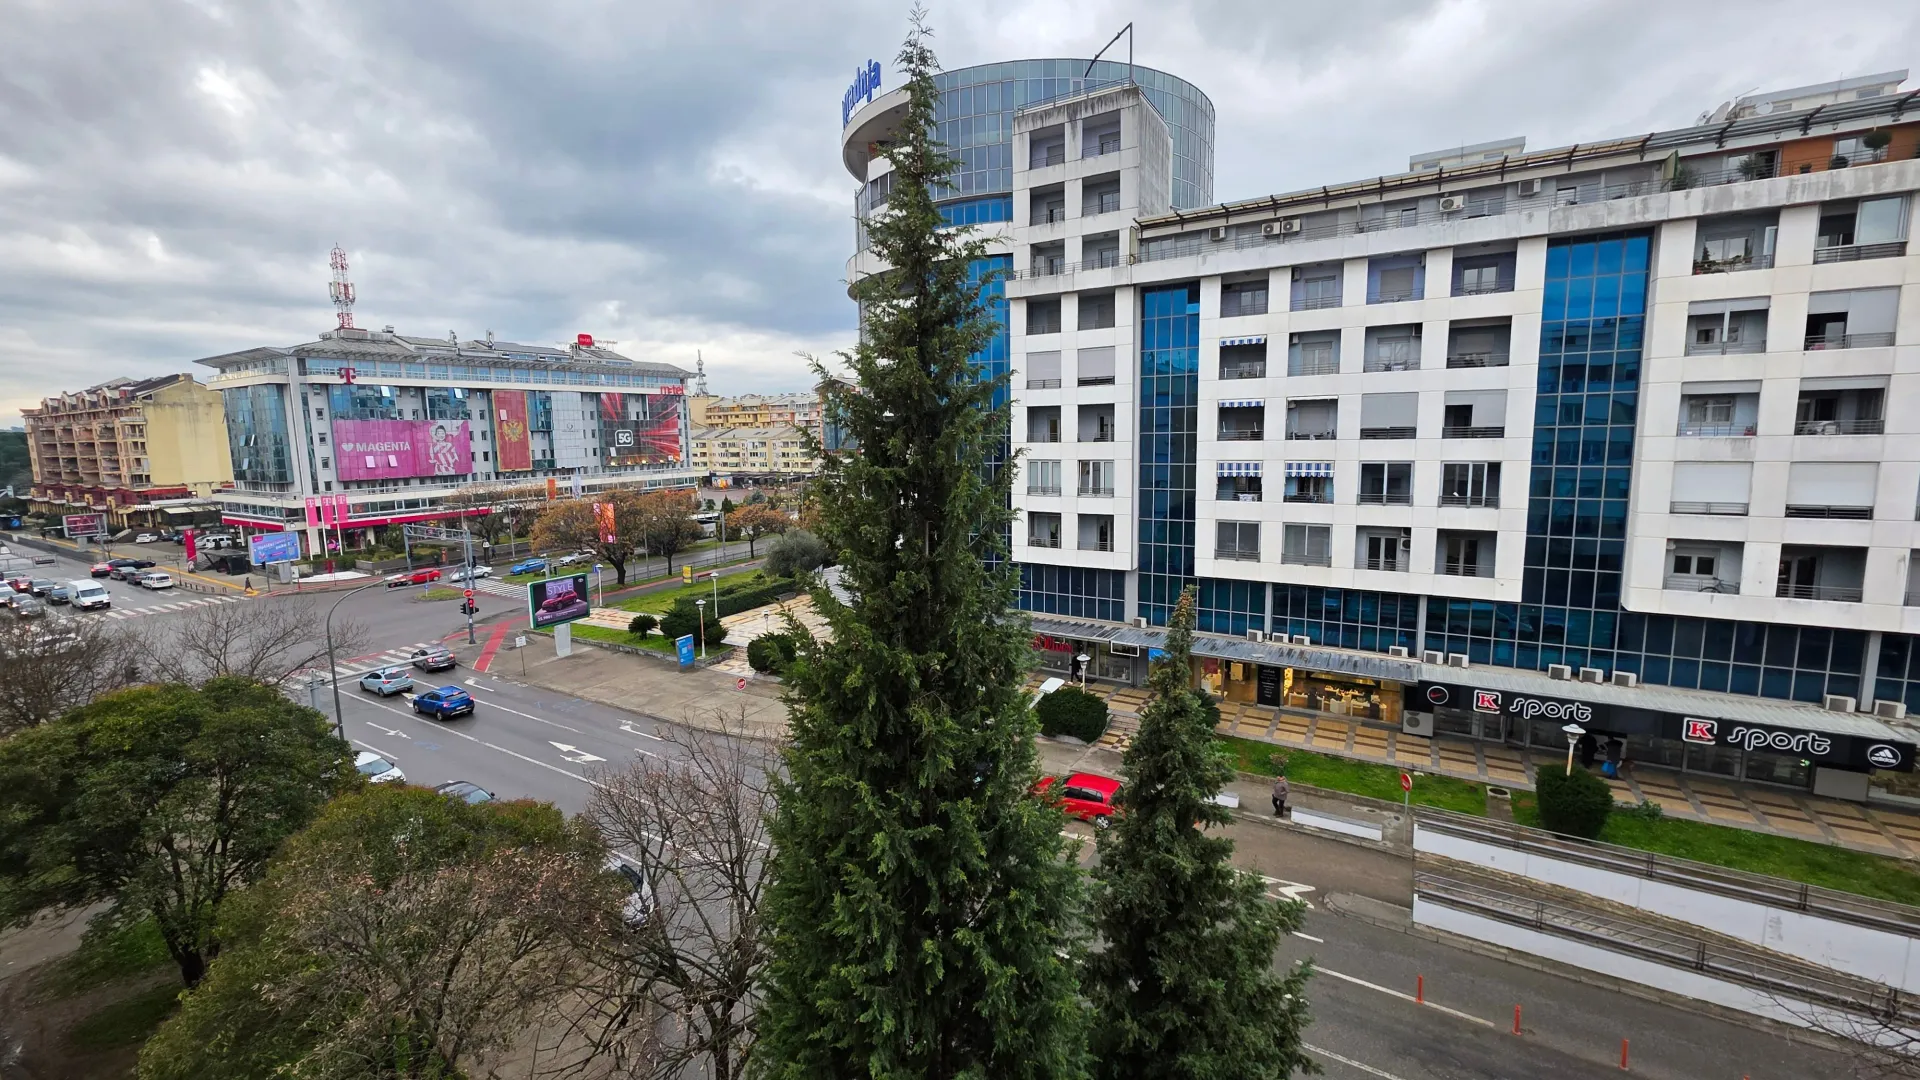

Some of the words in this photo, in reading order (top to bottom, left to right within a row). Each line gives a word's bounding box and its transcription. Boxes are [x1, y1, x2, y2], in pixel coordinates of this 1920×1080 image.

[618, 433, 631, 444] 5G
[356, 441, 411, 452] MAGENTA
[547, 582, 573, 595] STYLE
[1478, 692, 1500, 709] K
[1509, 697, 1592, 722] sport
[1689, 720, 1715, 739] K
[1727, 726, 1831, 755] sport
